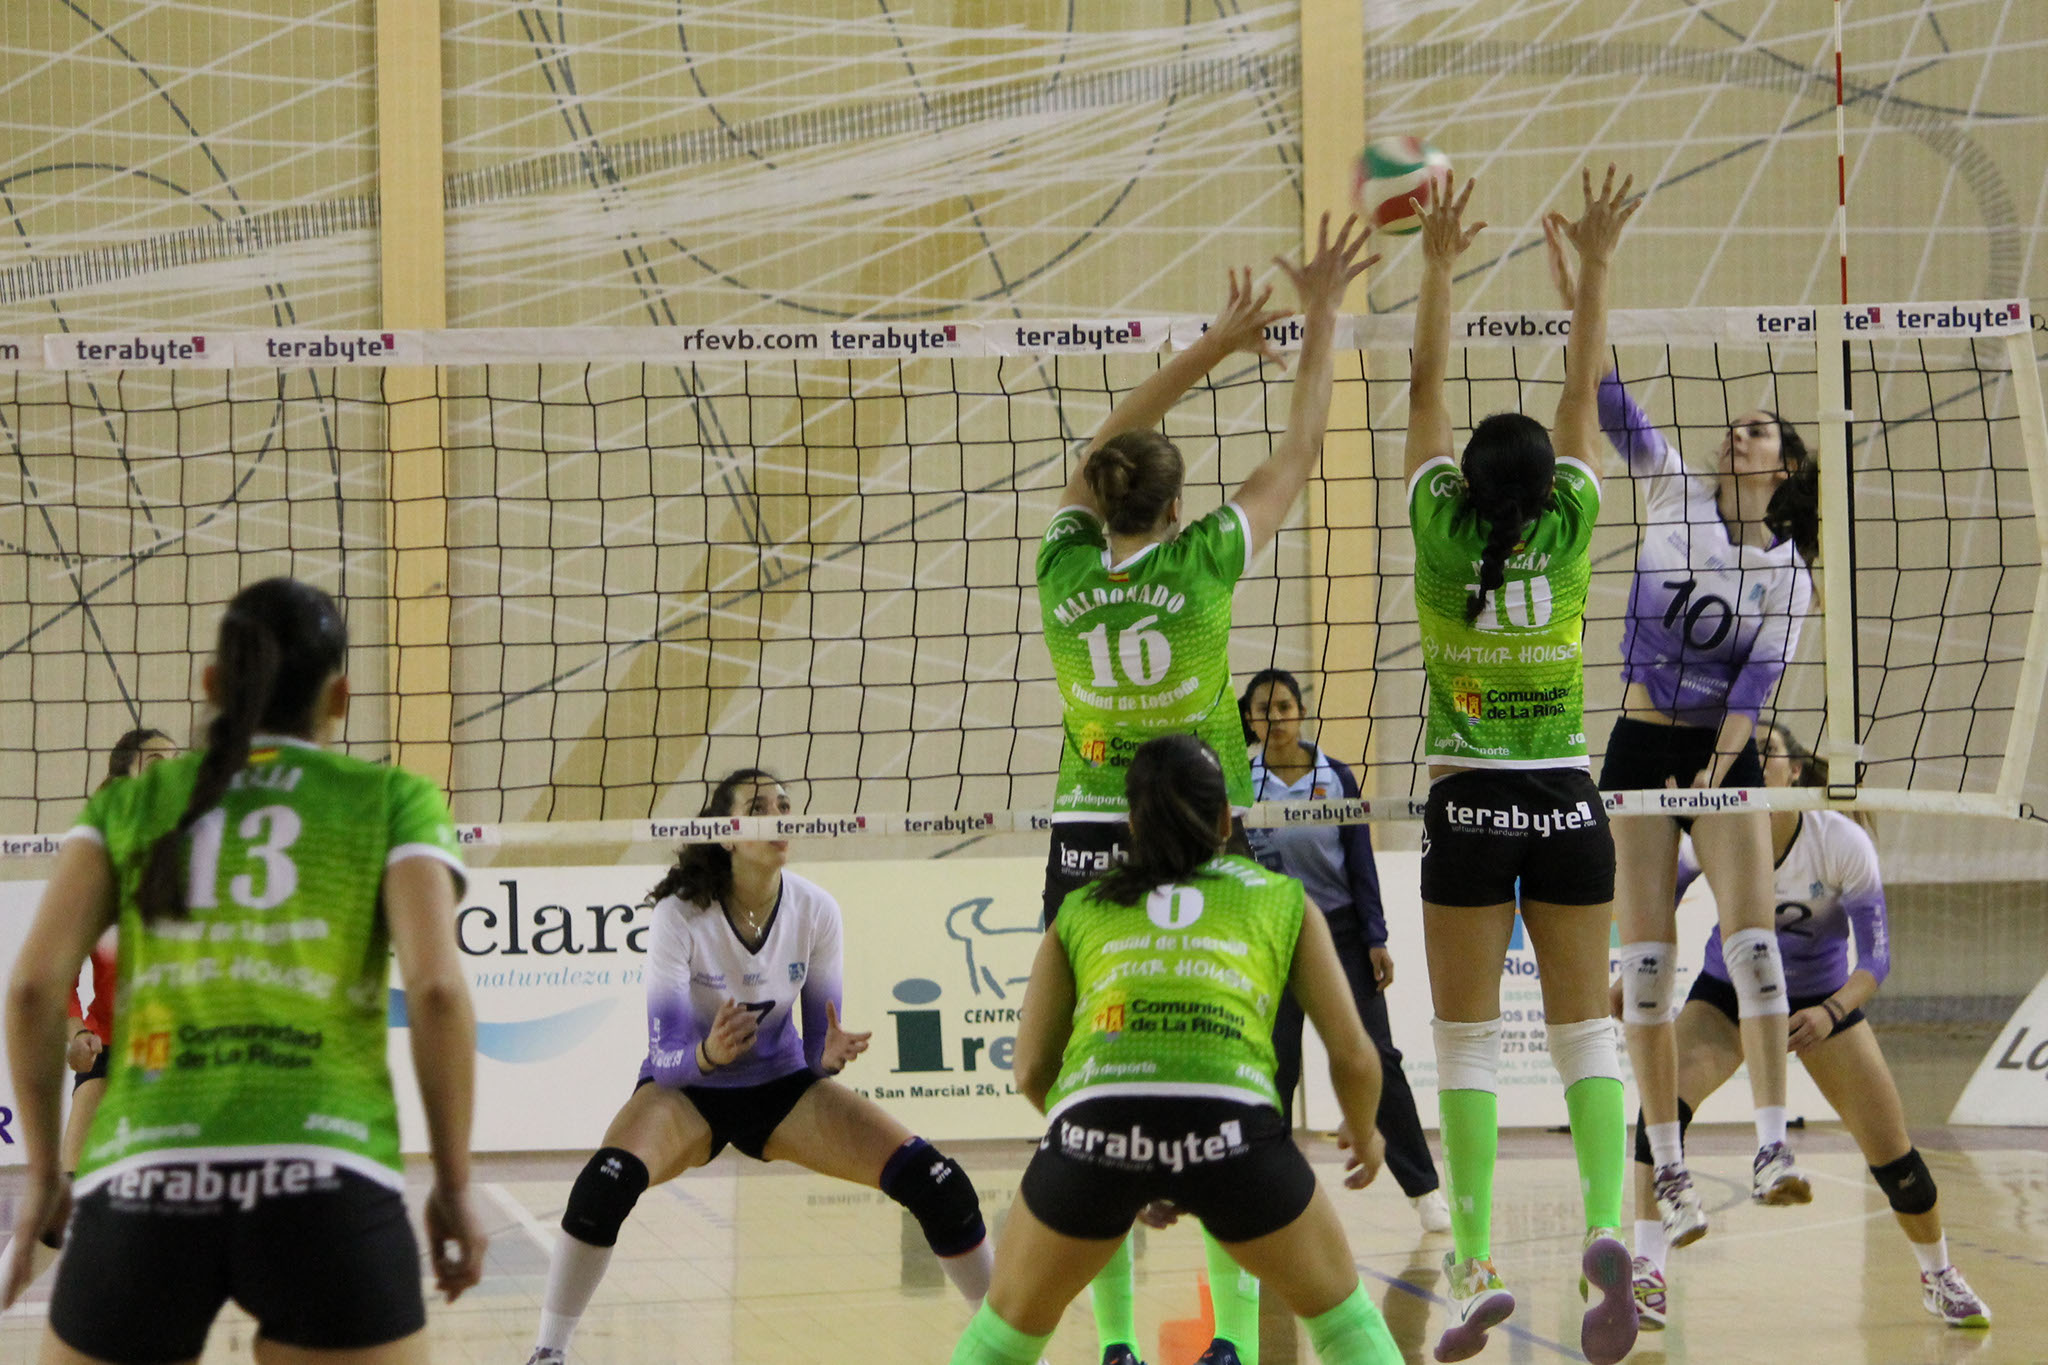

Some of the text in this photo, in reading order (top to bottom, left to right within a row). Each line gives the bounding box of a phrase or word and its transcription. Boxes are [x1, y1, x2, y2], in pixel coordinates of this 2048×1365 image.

[1467, 315, 1571, 337] rfevb.co
[1897, 306, 2008, 332] terabyte
[266, 335, 382, 362] terabyte
[683, 329, 818, 350] rfevb.com
[831, 327, 945, 354] terabyte
[1016, 324, 1130, 350] terabyte
[77, 338, 193, 364] terabyte
[1053, 584, 1186, 627] MALDONADO
[1662, 577, 1733, 651] 10
[1078, 615, 1172, 688] 16
[1444, 641, 1578, 664] NATUR HOUSE
[1487, 706, 1506, 719] de
[1510, 705, 1529, 719] La
[1660, 791, 1739, 811] terabyte
[904, 815, 985, 834] terabyte
[1284, 805, 1363, 823] terabyte
[1445, 801, 1582, 838] terabyte
[651, 820, 731, 840] terabyte
[776, 817, 857, 838] terabyte
[186, 805, 302, 910] 13
[476, 964, 642, 989] naturaleza vi
[1162, 1017, 1186, 1032] La
[875, 1086, 905, 1098] San
[911, 1084, 970, 1098] Marcial
